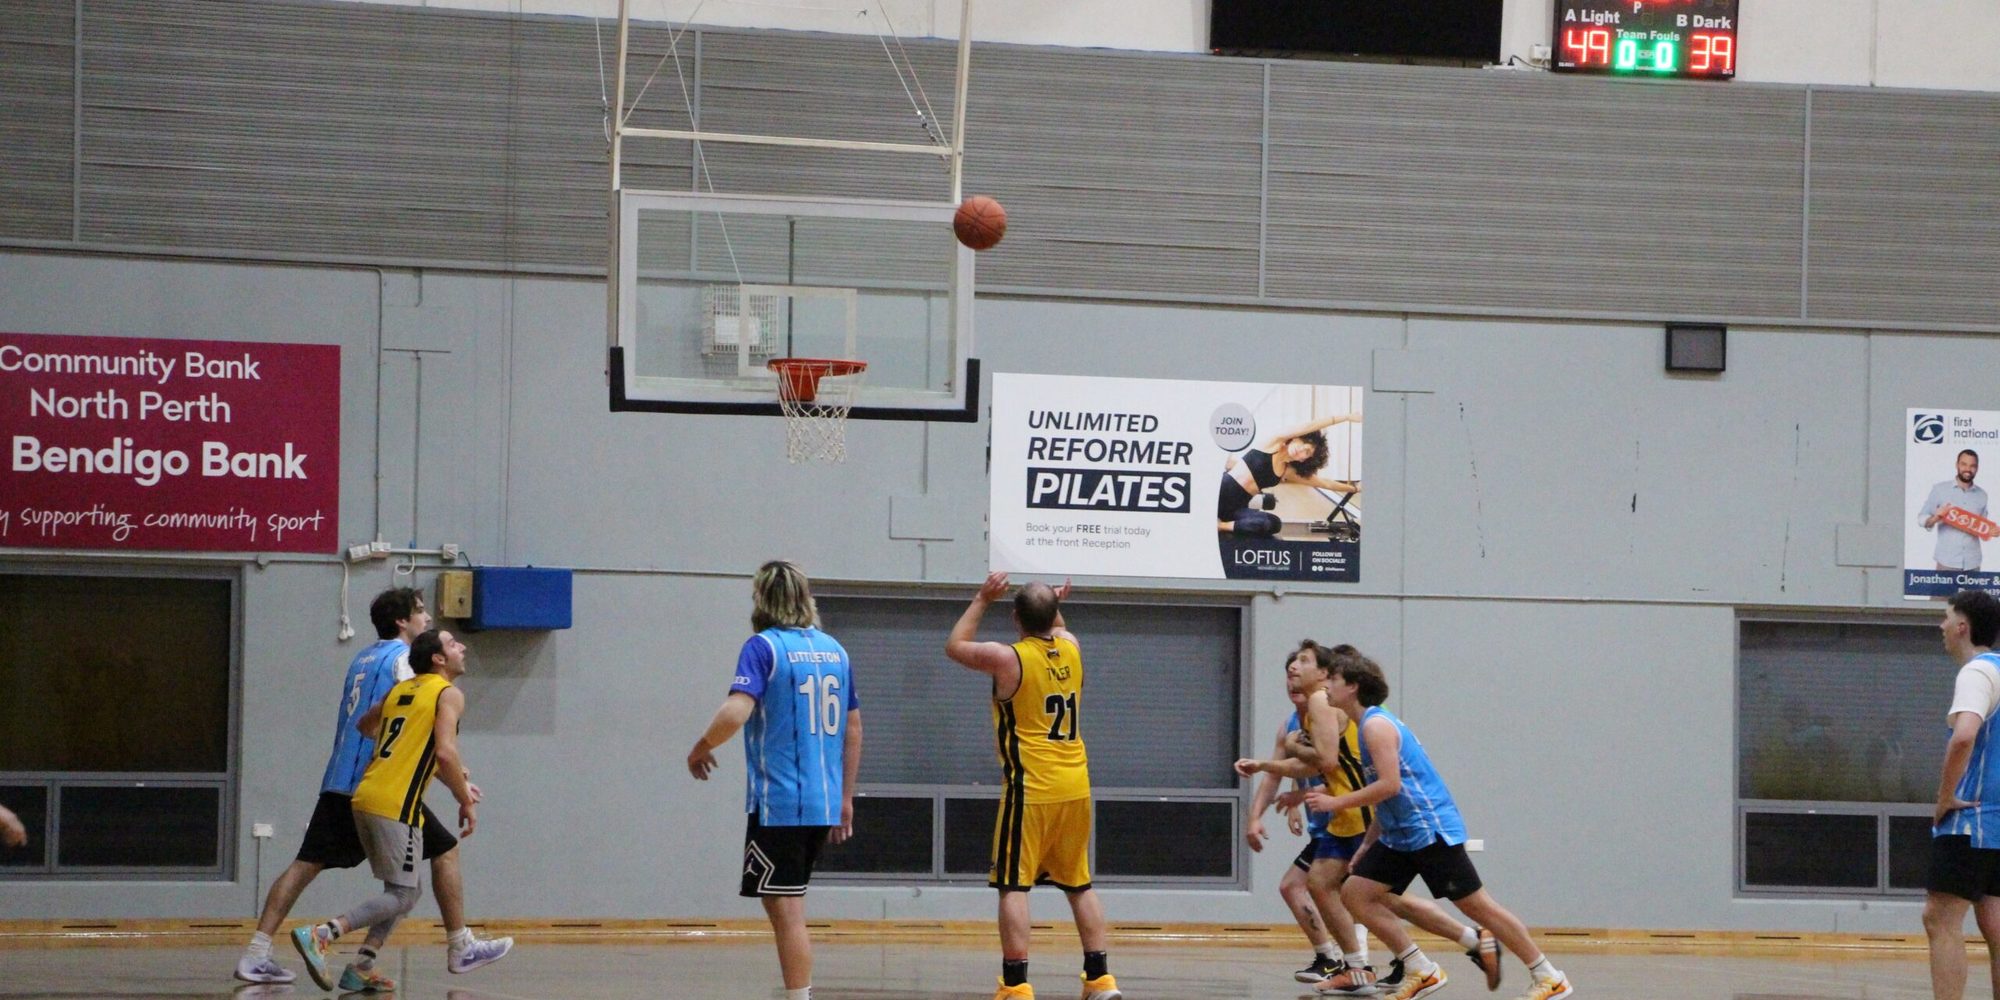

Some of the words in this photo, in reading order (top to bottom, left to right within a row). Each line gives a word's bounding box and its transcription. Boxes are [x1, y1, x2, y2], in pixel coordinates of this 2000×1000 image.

[1565, 9, 1577, 22] A
[1581, 10, 1620, 26] Light
[1633, 1, 1642, 14] P
[1616, 29, 1647, 40] Team
[1650, 30, 1680, 41] Fouls
[1676, 14, 1688, 27] B
[1693, 15, 1732, 29] Dark
[1567, 30, 1609, 64] 49
[1618, 40, 1636, 69] 0
[1655, 42, 1673, 69] 0
[1691, 35, 1732, 70] 39
[0, 345, 176, 384] Community
[185, 352, 261, 380] Bank
[30, 388, 128, 420] North
[140, 391, 231, 423] Perth
[1028, 410, 1159, 433] UNLIMITED
[1216, 427, 1250, 435] TODAY!
[1221, 417, 1243, 425] JOIN
[1954, 416, 1972, 427] first
[1954, 428, 1999, 439] national
[12, 435, 189, 487] Bendigo
[202, 441, 307, 479] Bank
[1027, 436, 1193, 466] REFORMER
[1031, 472, 1187, 509] PILATES
[20, 504, 138, 541] supporting
[144, 507, 257, 542] community
[267, 509, 324, 541] sport
[1025, 522, 1050, 532] Book
[1052, 525, 1073, 535] your
[1076, 524, 1101, 534] FREE
[1104, 526, 1122, 535] trial
[1124, 527, 1151, 538] today
[1947, 508, 1990, 535] SOLD
[1025, 538, 1035, 546] at
[1038, 537, 1053, 546] the
[1056, 538, 1079, 547] front
[1082, 538, 1131, 549] Reception
[1235, 549, 1291, 566] LOFTUS
[1909, 573, 1953, 585] Jonathan
[1956, 574, 1990, 586] Clover
[787, 651, 841, 663] LITTLETON
[347, 673, 366, 717] 5
[799, 674, 840, 736] 16
[1045, 691, 1077, 741] 21
[379, 716, 406, 759] 12
